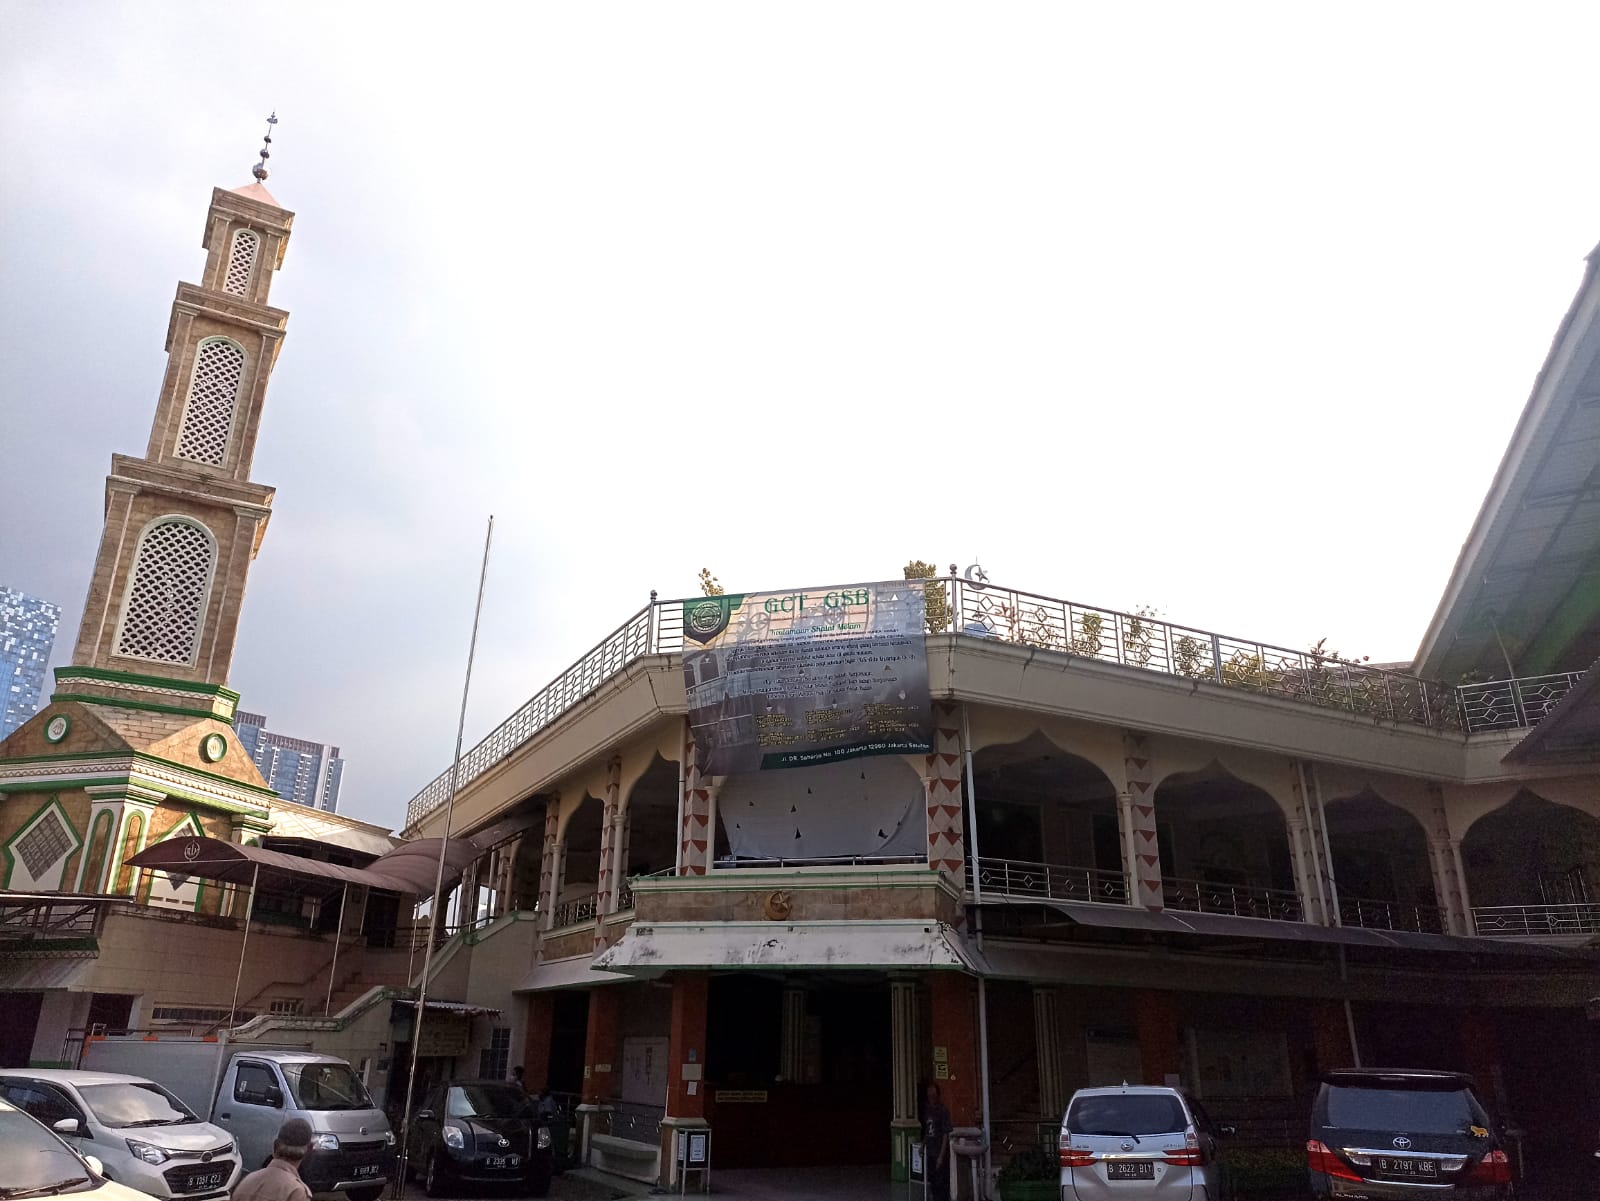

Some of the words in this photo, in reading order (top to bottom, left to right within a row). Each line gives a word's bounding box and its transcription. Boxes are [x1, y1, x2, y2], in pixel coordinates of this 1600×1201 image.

[824, 589, 869, 608] GSB
[1108, 1164, 1114, 1173] B
[1119, 1164, 1135, 1173] 2622
[1381, 1159, 1387, 1169] B
[1394, 1159, 1413, 1170] 2797
